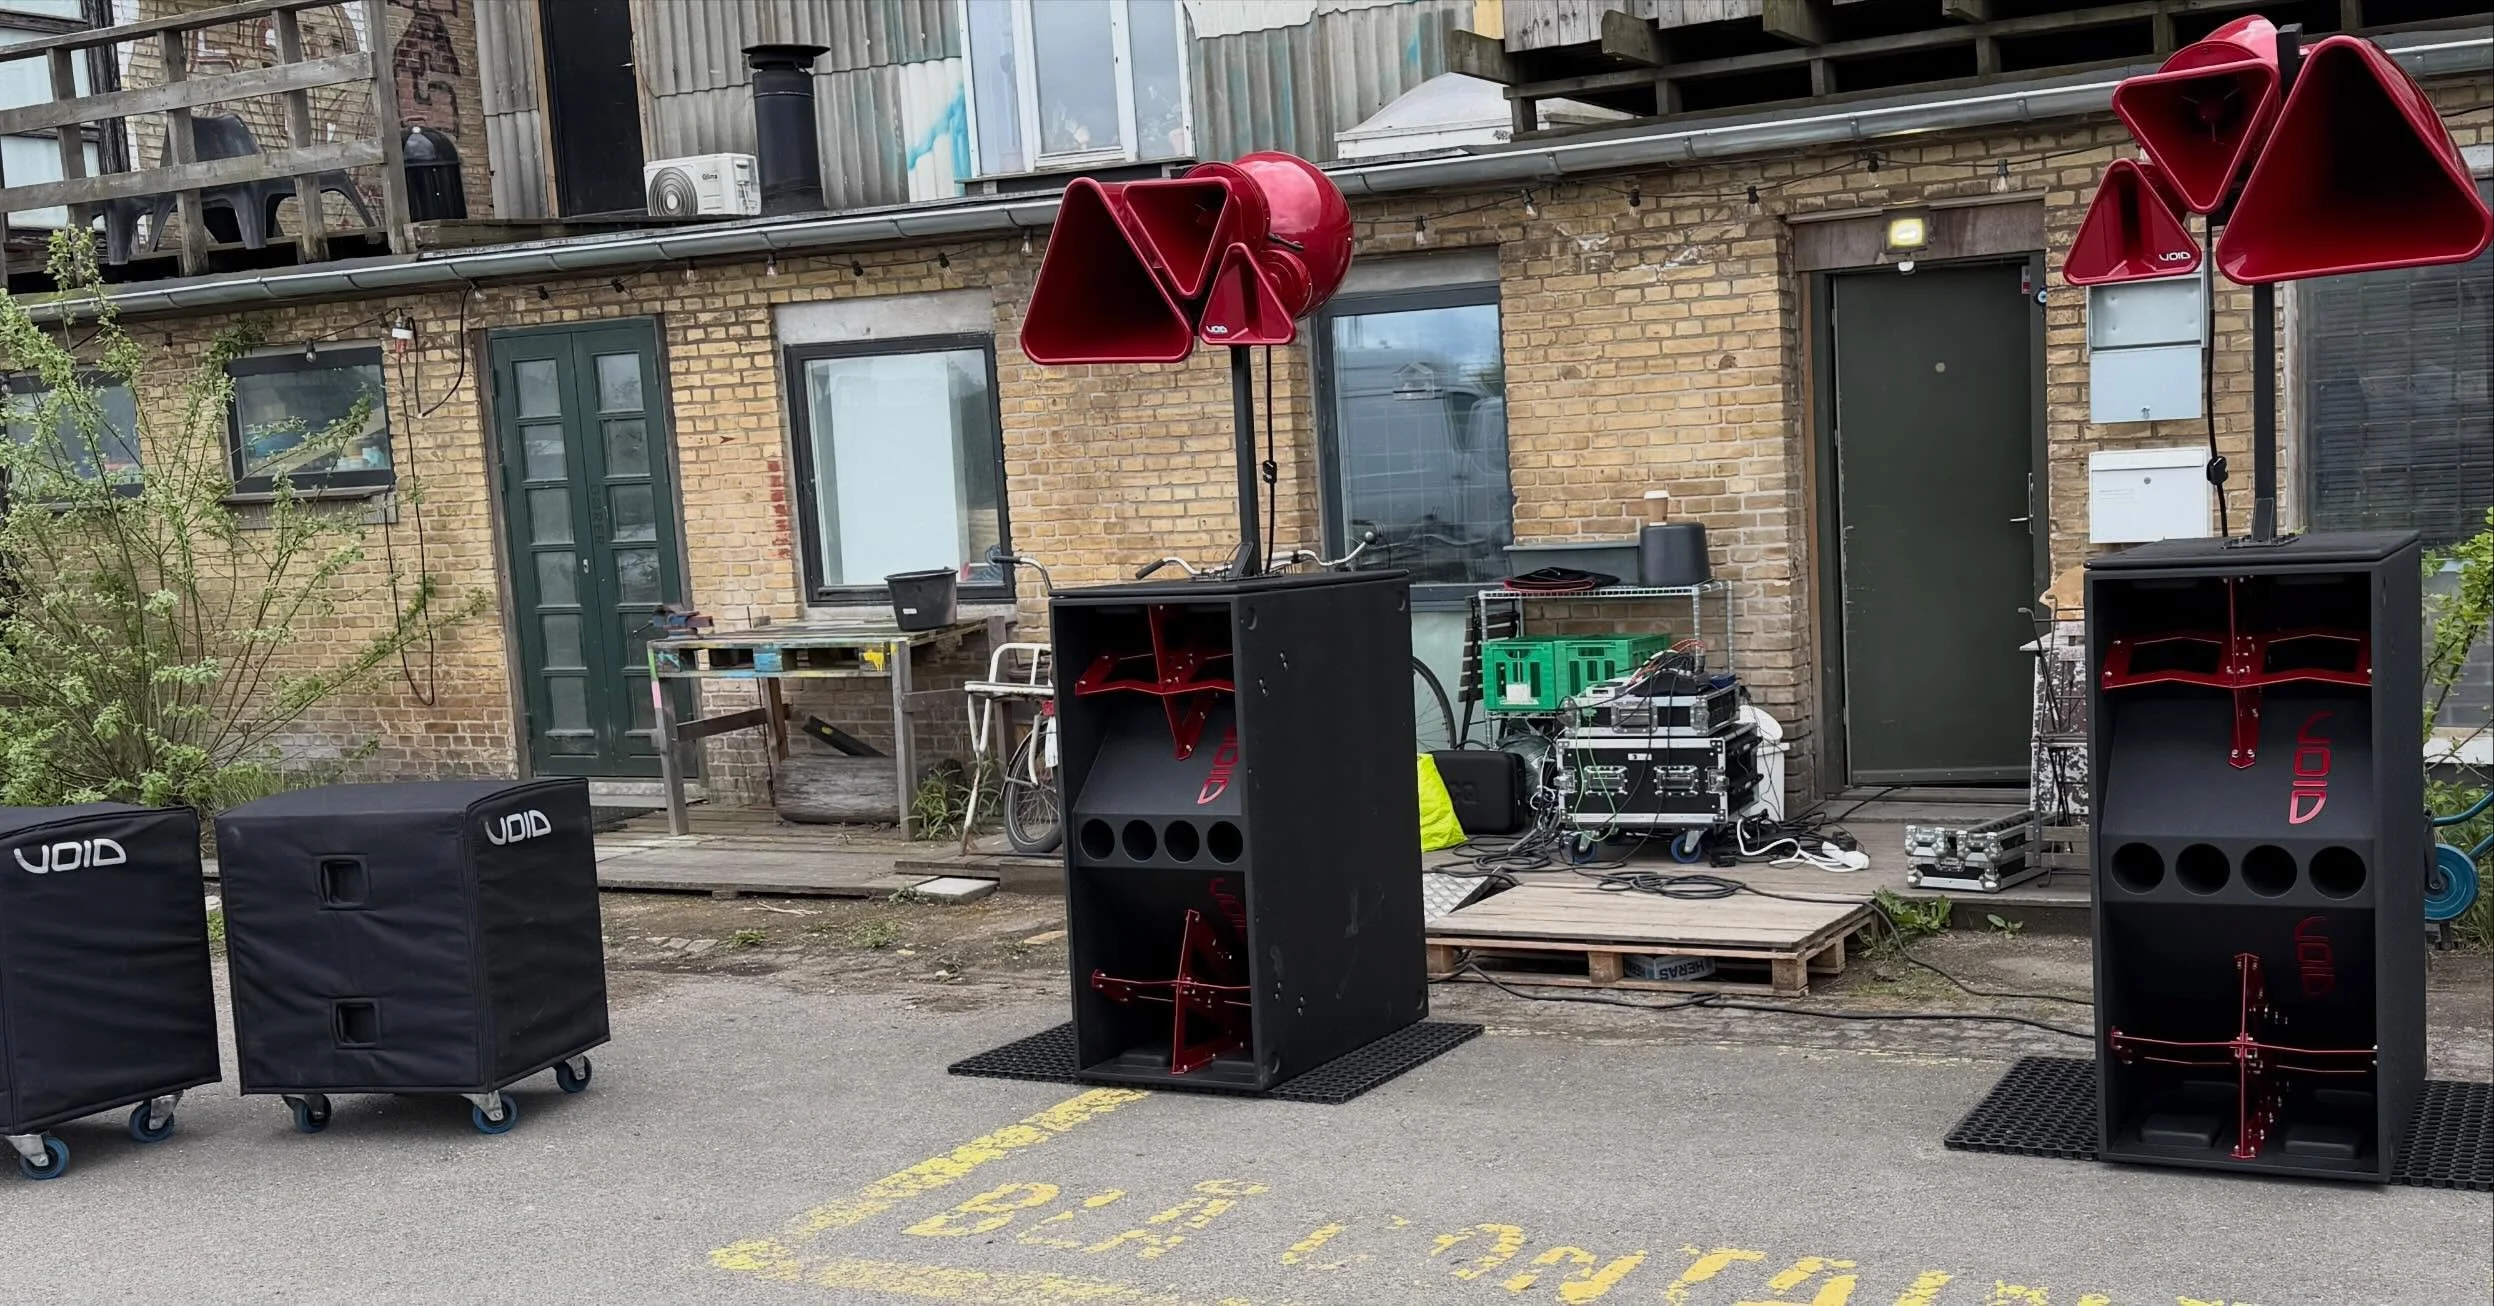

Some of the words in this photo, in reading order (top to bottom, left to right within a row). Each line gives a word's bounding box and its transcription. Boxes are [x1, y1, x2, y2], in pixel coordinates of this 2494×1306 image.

[2158, 251, 2191, 261] VOID
[2289, 709, 2335, 824] VOID
[485, 809, 552, 846] VOID
[13, 838, 127, 874] VOID
[1659, 960, 1706, 980] HERAS
